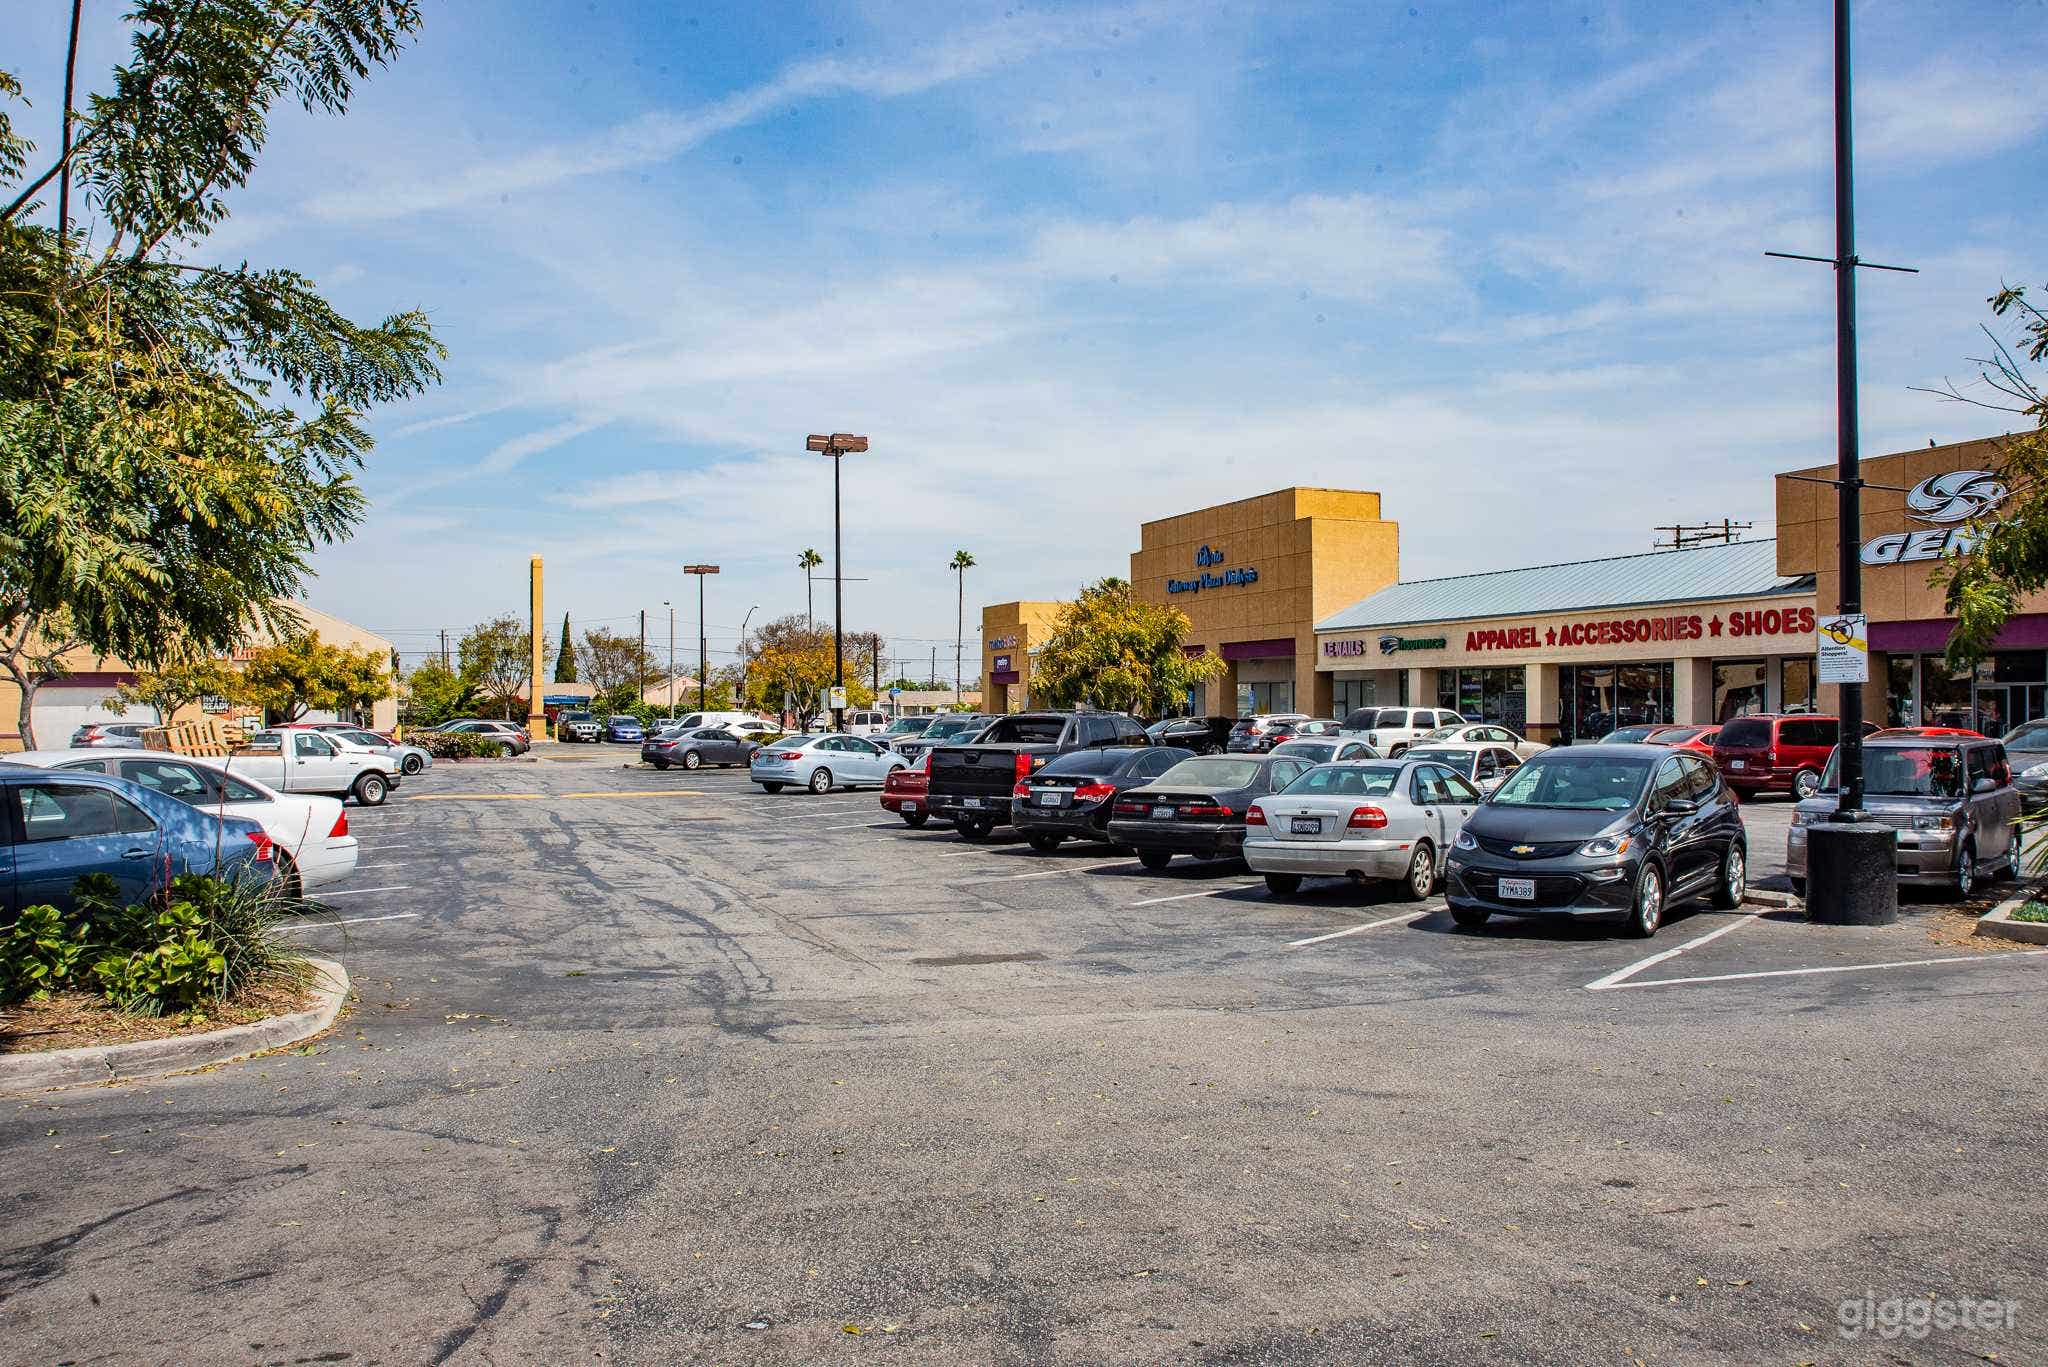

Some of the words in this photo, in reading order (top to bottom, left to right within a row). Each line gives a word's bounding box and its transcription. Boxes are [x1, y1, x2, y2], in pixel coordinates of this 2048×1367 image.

[1465, 627, 1541, 651] APPAREL
[1559, 615, 1702, 647] ACCESSORIES
[1728, 607, 1815, 637] SHOES
[203, 703, 229, 711] READY
